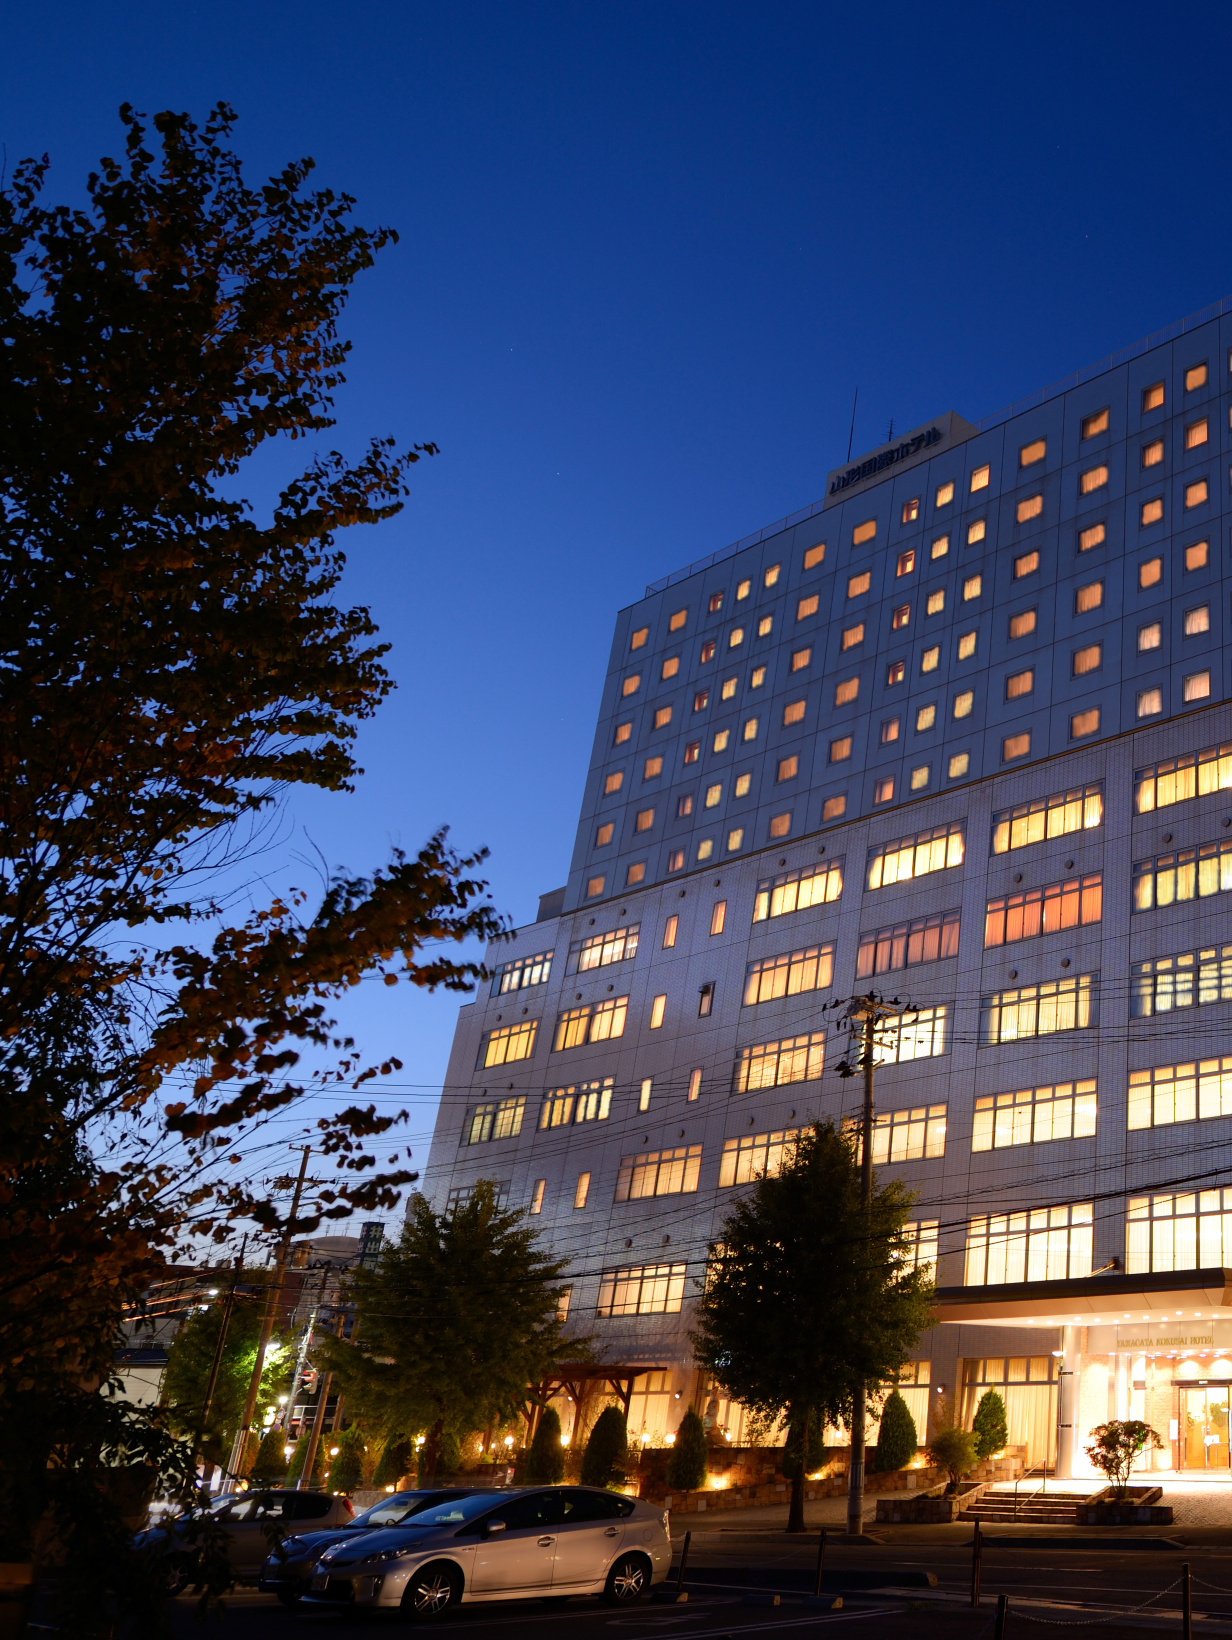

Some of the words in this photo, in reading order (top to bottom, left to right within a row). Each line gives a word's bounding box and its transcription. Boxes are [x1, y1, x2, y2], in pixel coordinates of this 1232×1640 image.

[829, 426, 943, 495] 山形国際ホテル
[1117, 1338, 1154, 1348] YAMAGATA
[1156, 1337, 1188, 1347] KOKUSAI
[1190, 1335, 1214, 1345] HOTEL
